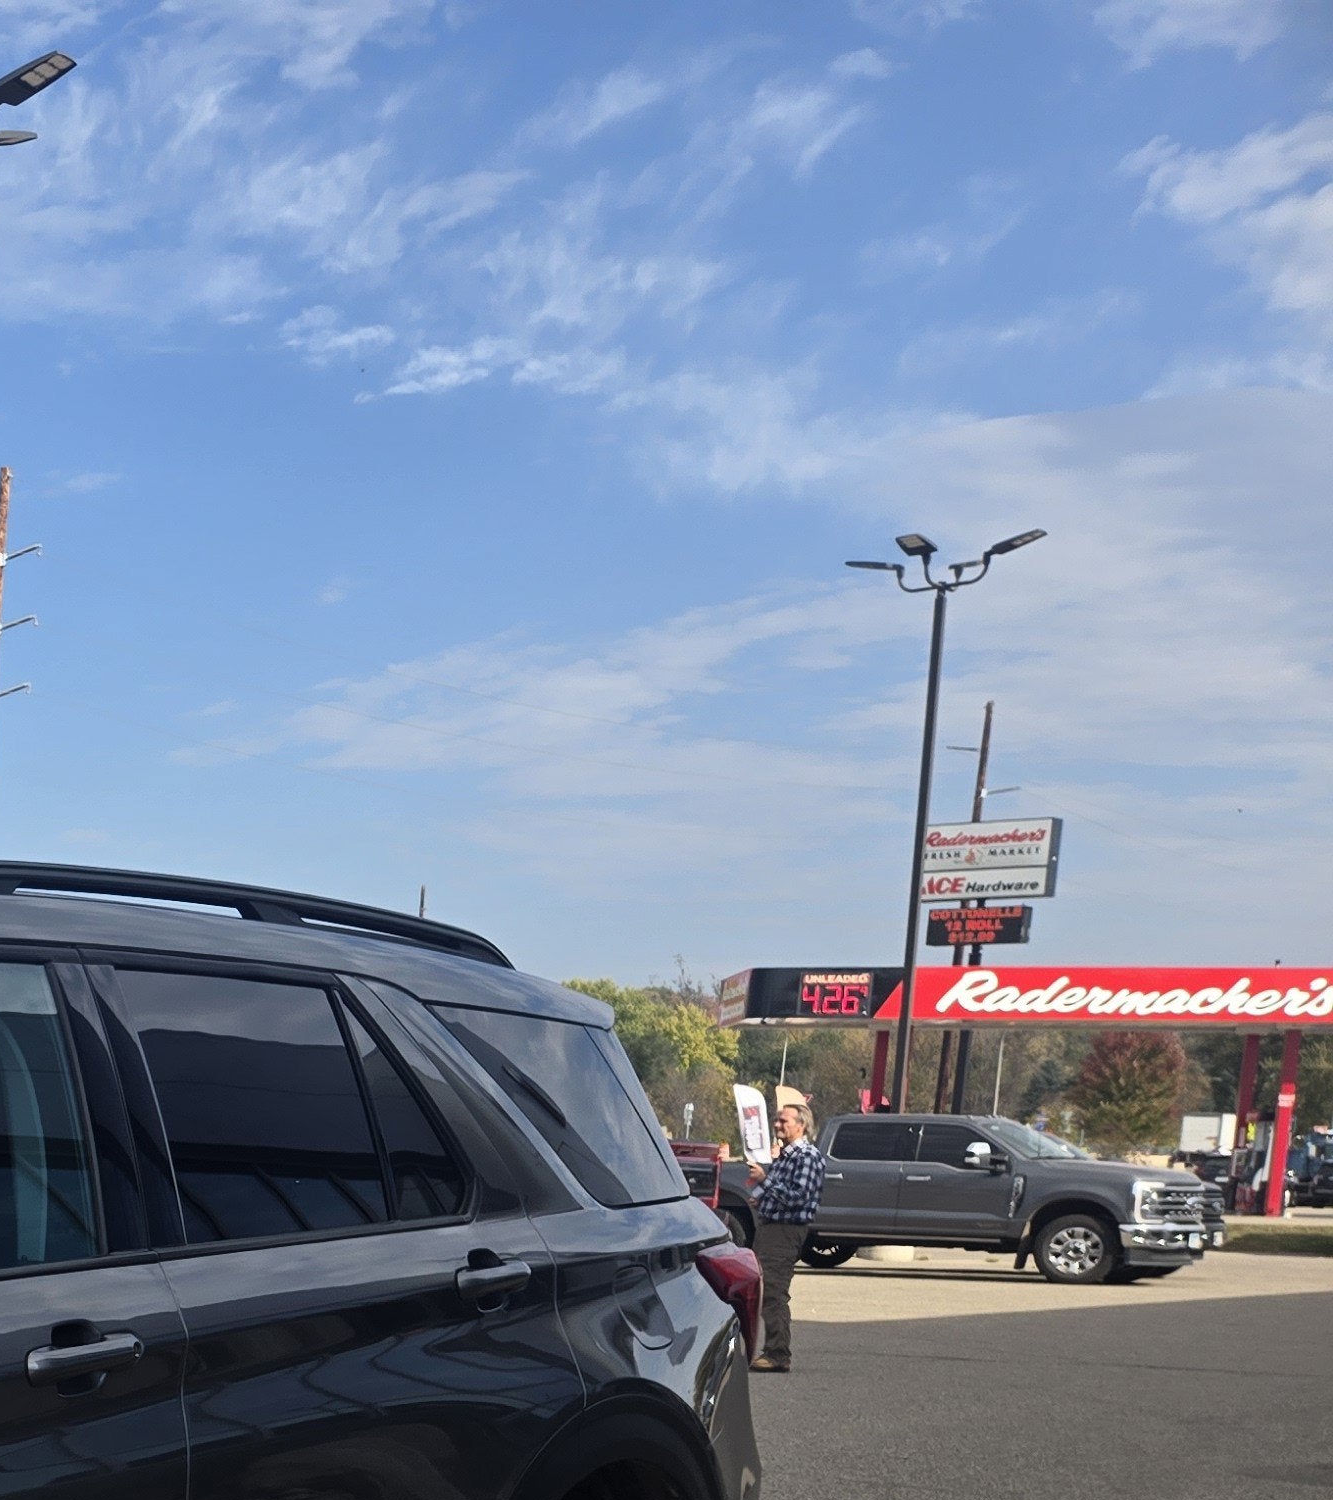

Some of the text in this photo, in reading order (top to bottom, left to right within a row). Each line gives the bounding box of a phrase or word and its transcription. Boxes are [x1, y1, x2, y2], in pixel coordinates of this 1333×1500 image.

[925, 828, 1046, 847] Radermacher's
[965, 881, 1039, 893] Hardware
[936, 970, 1333, 1016] Radermacher's
